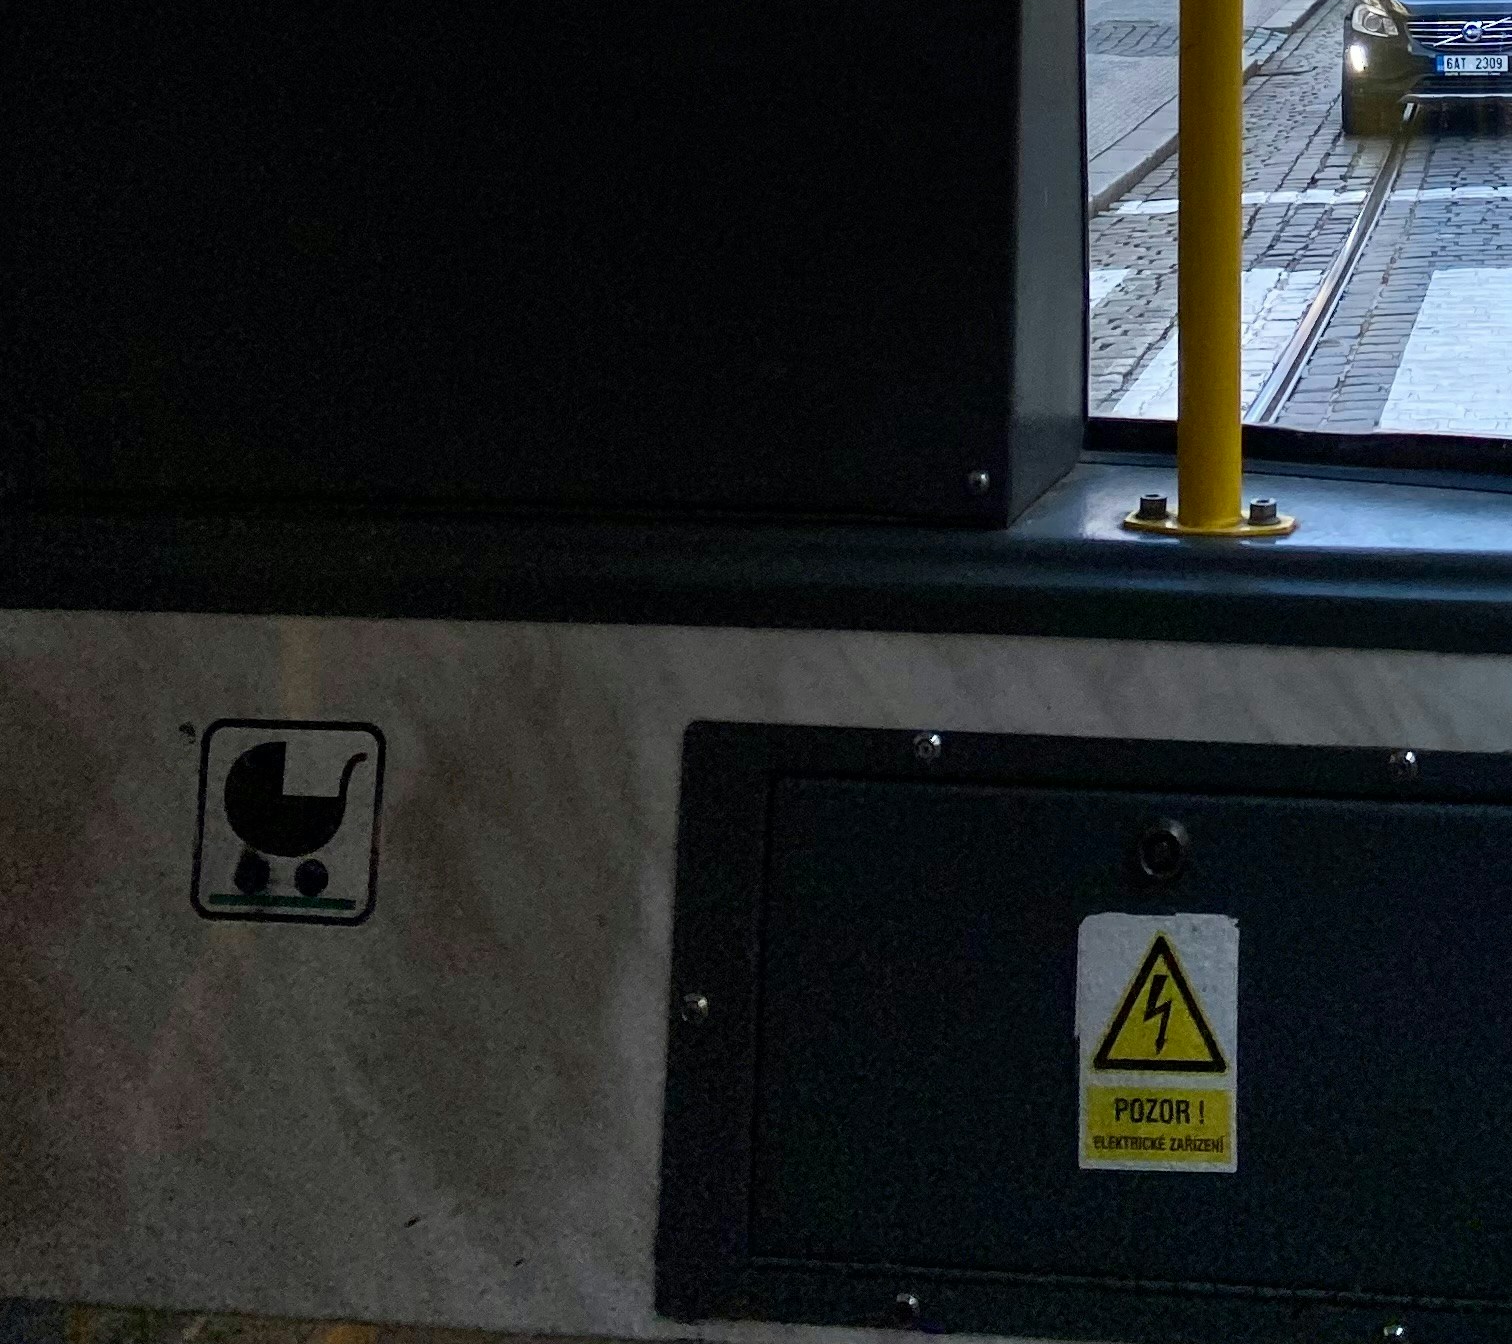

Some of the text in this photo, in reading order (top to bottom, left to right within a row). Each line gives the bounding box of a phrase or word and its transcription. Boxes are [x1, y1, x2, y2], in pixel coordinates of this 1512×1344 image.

[1446, 57, 1503, 70] 6AT 2309
[1114, 1097, 1191, 1124] POZOR
[1092, 1134, 1225, 1153] ELEKTRICKÉ ZAŘÍZENÍ
